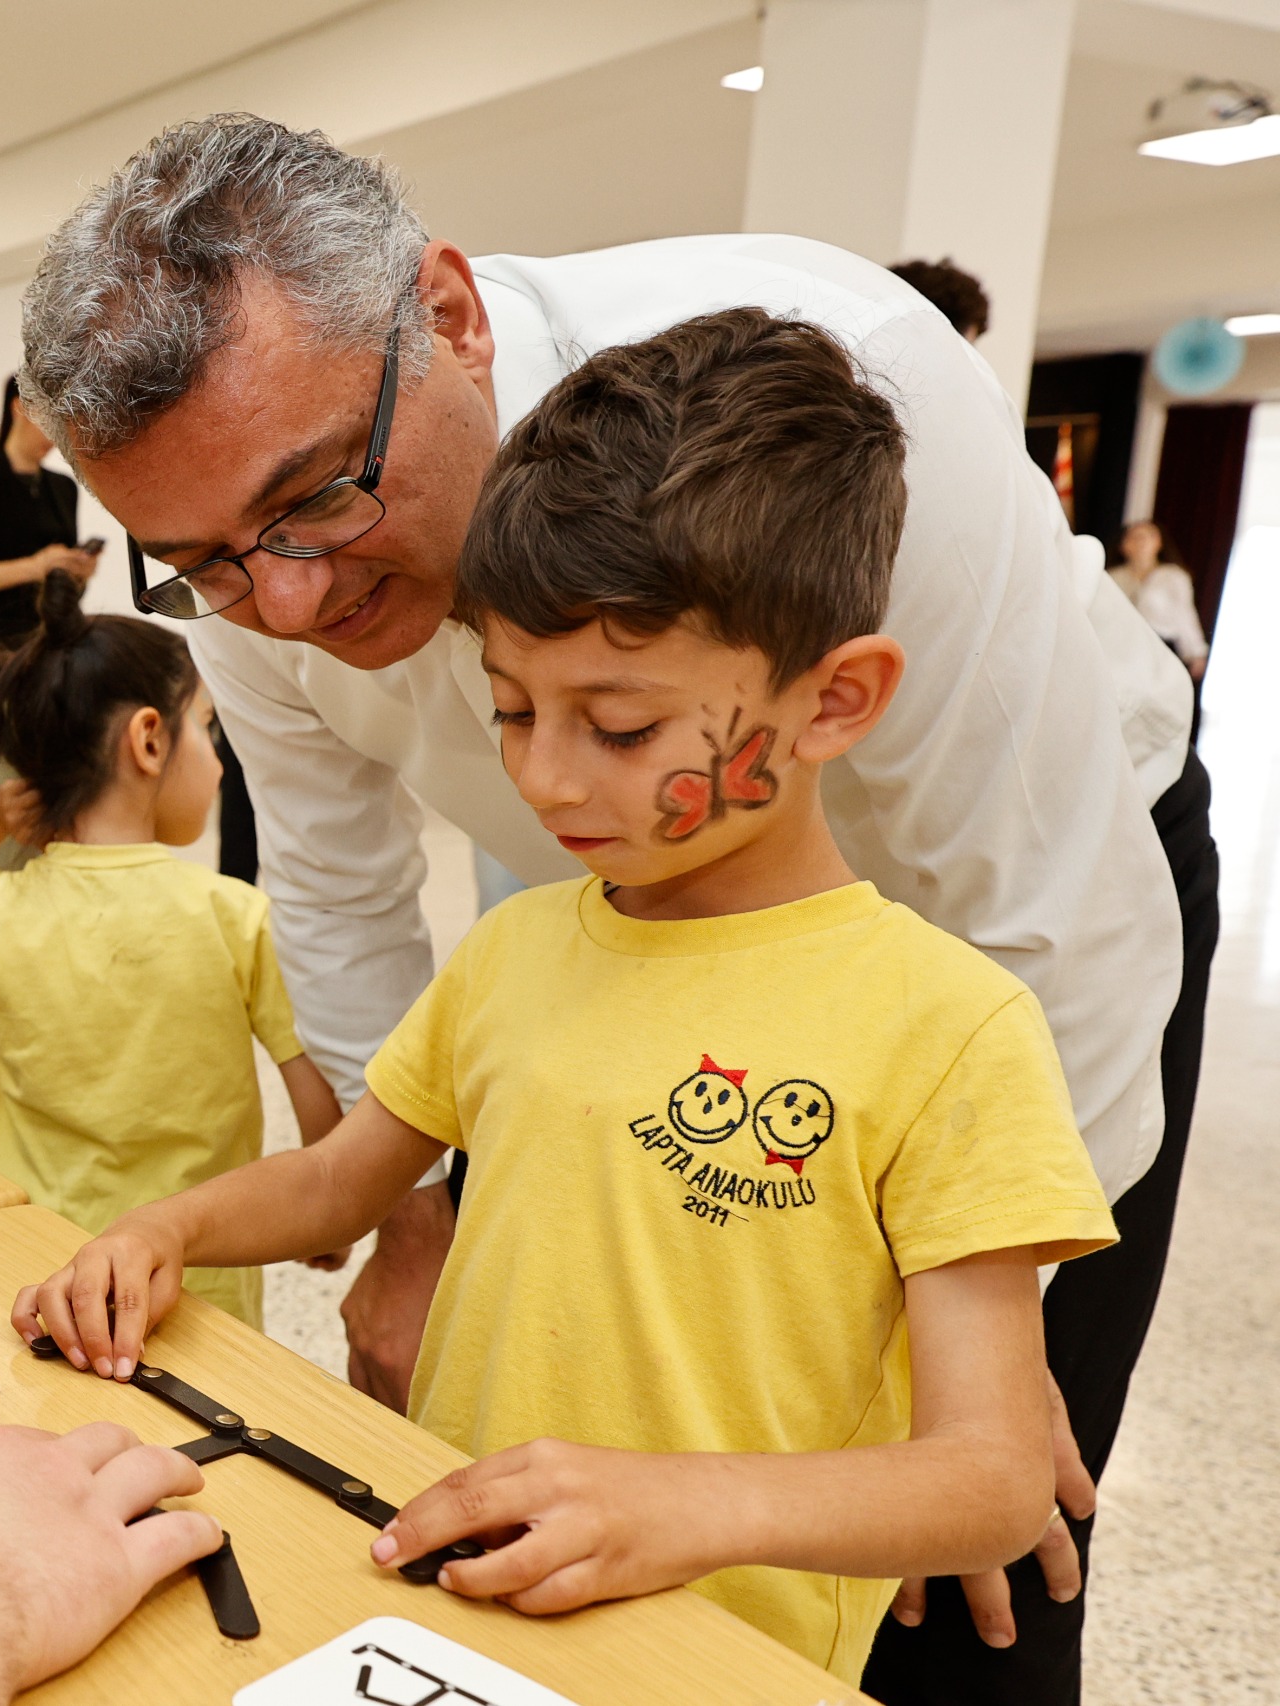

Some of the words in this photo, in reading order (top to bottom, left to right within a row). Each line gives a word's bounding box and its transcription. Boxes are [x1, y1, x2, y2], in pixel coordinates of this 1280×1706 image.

[628, 1113, 695, 1175] LAPTA
[687, 1162, 816, 1210] ANAOKULU
[682, 1195, 731, 1228] 2011
